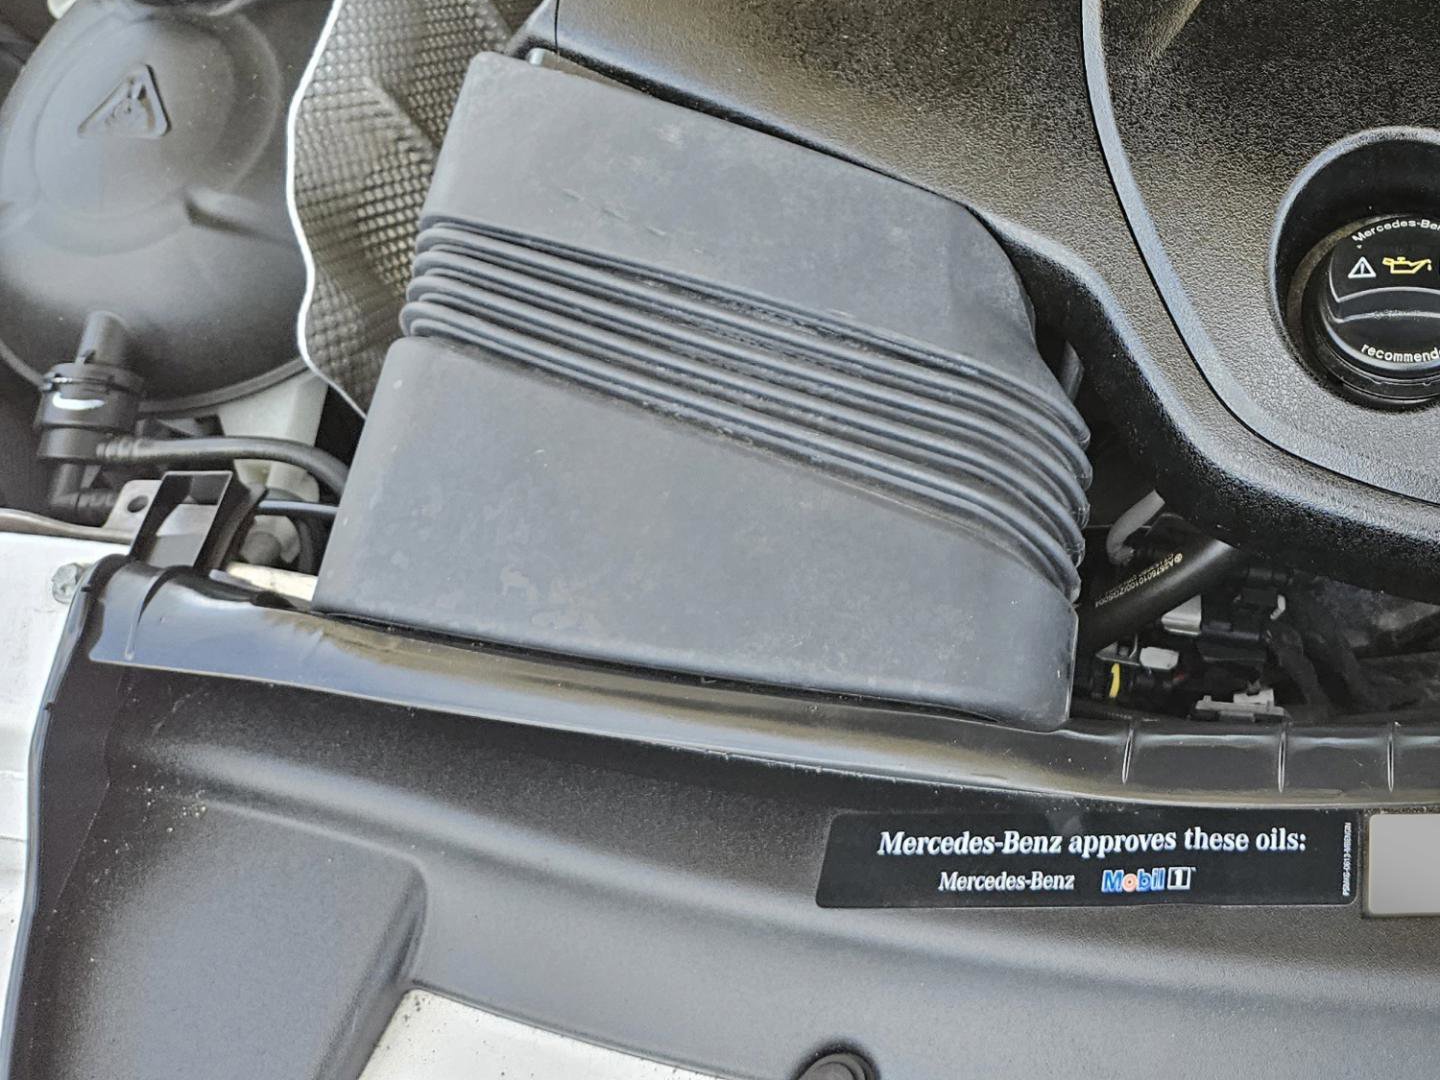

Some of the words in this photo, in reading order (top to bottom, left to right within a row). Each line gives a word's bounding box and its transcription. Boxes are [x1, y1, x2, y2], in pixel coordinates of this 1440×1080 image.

[877, 830, 1062, 856] Mercedes-Benz
[1067, 829, 1177, 859] approves
[1184, 826, 1250, 852] these
[1255, 826, 1307, 852] oils:
[938, 870, 1075, 892] Mercedes-Benz
[1101, 867, 1166, 893] Mobil
